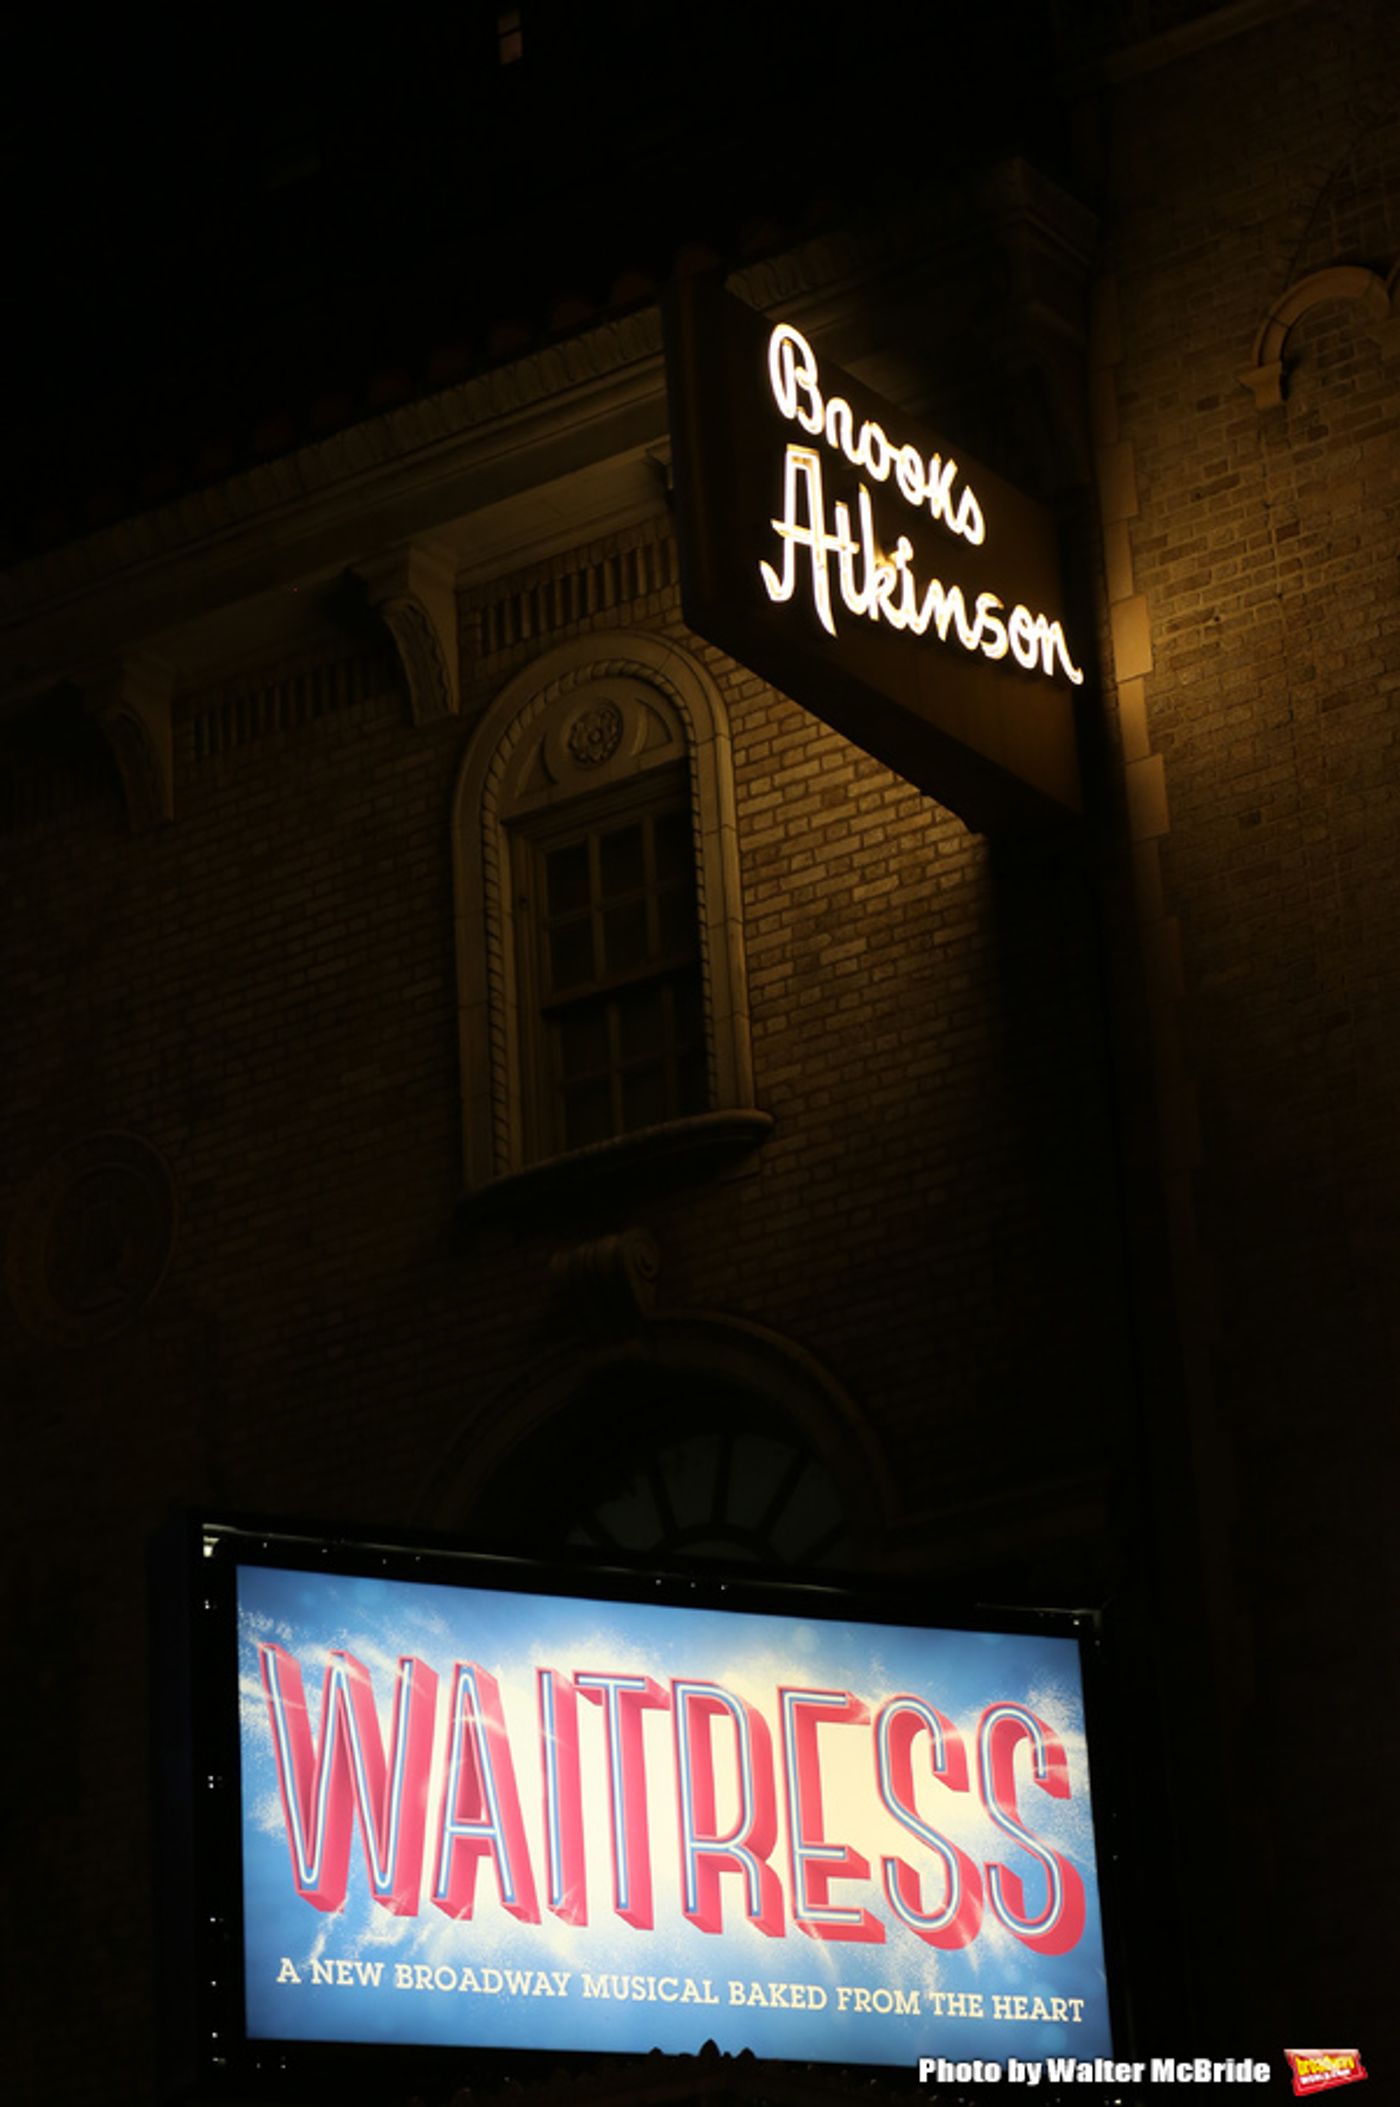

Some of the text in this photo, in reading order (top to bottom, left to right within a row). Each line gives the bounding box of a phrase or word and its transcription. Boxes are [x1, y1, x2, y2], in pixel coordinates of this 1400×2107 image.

[768, 323, 985, 545] Brooks
[759, 443, 1083, 685] Atkinson
[258, 1642, 1086, 1956] WAITRESS
[276, 1957, 1085, 2023] A NEW BROADWAY MUSICAL BAKED FROM THE HEART
